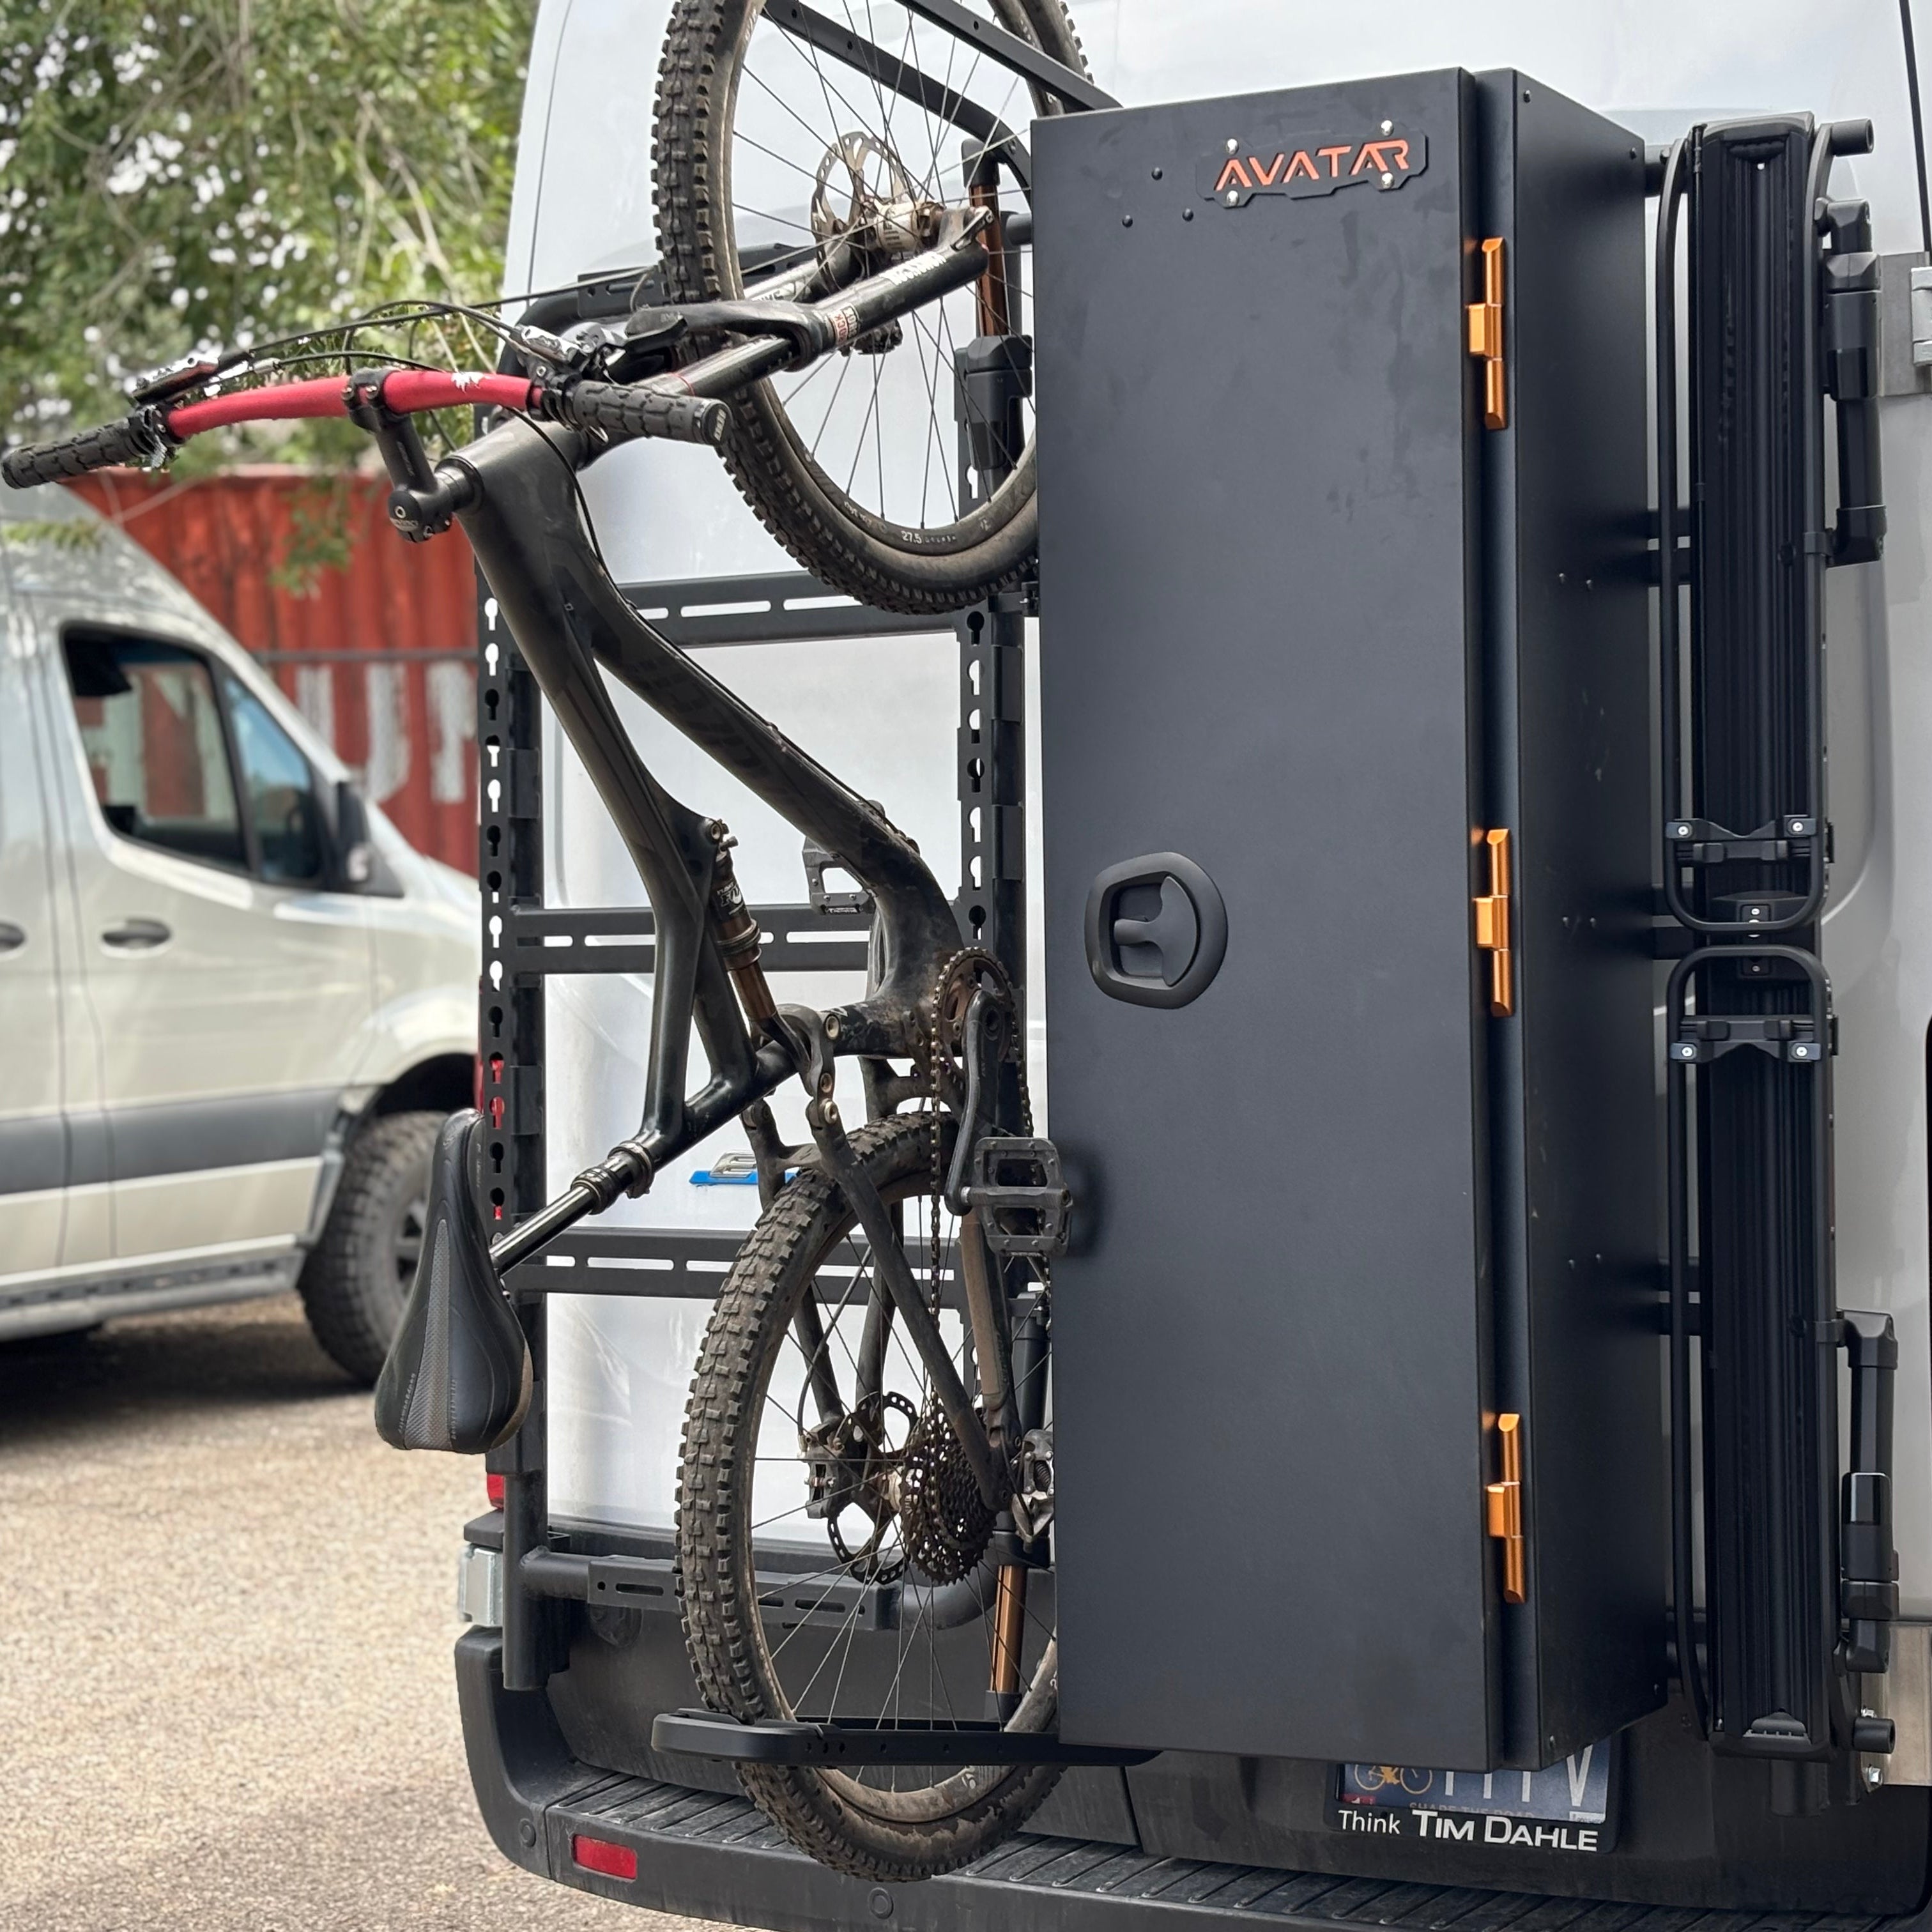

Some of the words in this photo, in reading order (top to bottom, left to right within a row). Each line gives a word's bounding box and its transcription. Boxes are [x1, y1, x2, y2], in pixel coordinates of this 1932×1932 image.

[1214, 139, 1409, 192] AVATAR
[900, 530, 923, 544] 27.5
[1338, 1809, 1401, 1836] Think
[1411, 1809, 1475, 1841] TIM
[1483, 1815, 1598, 1852] DAHLE
